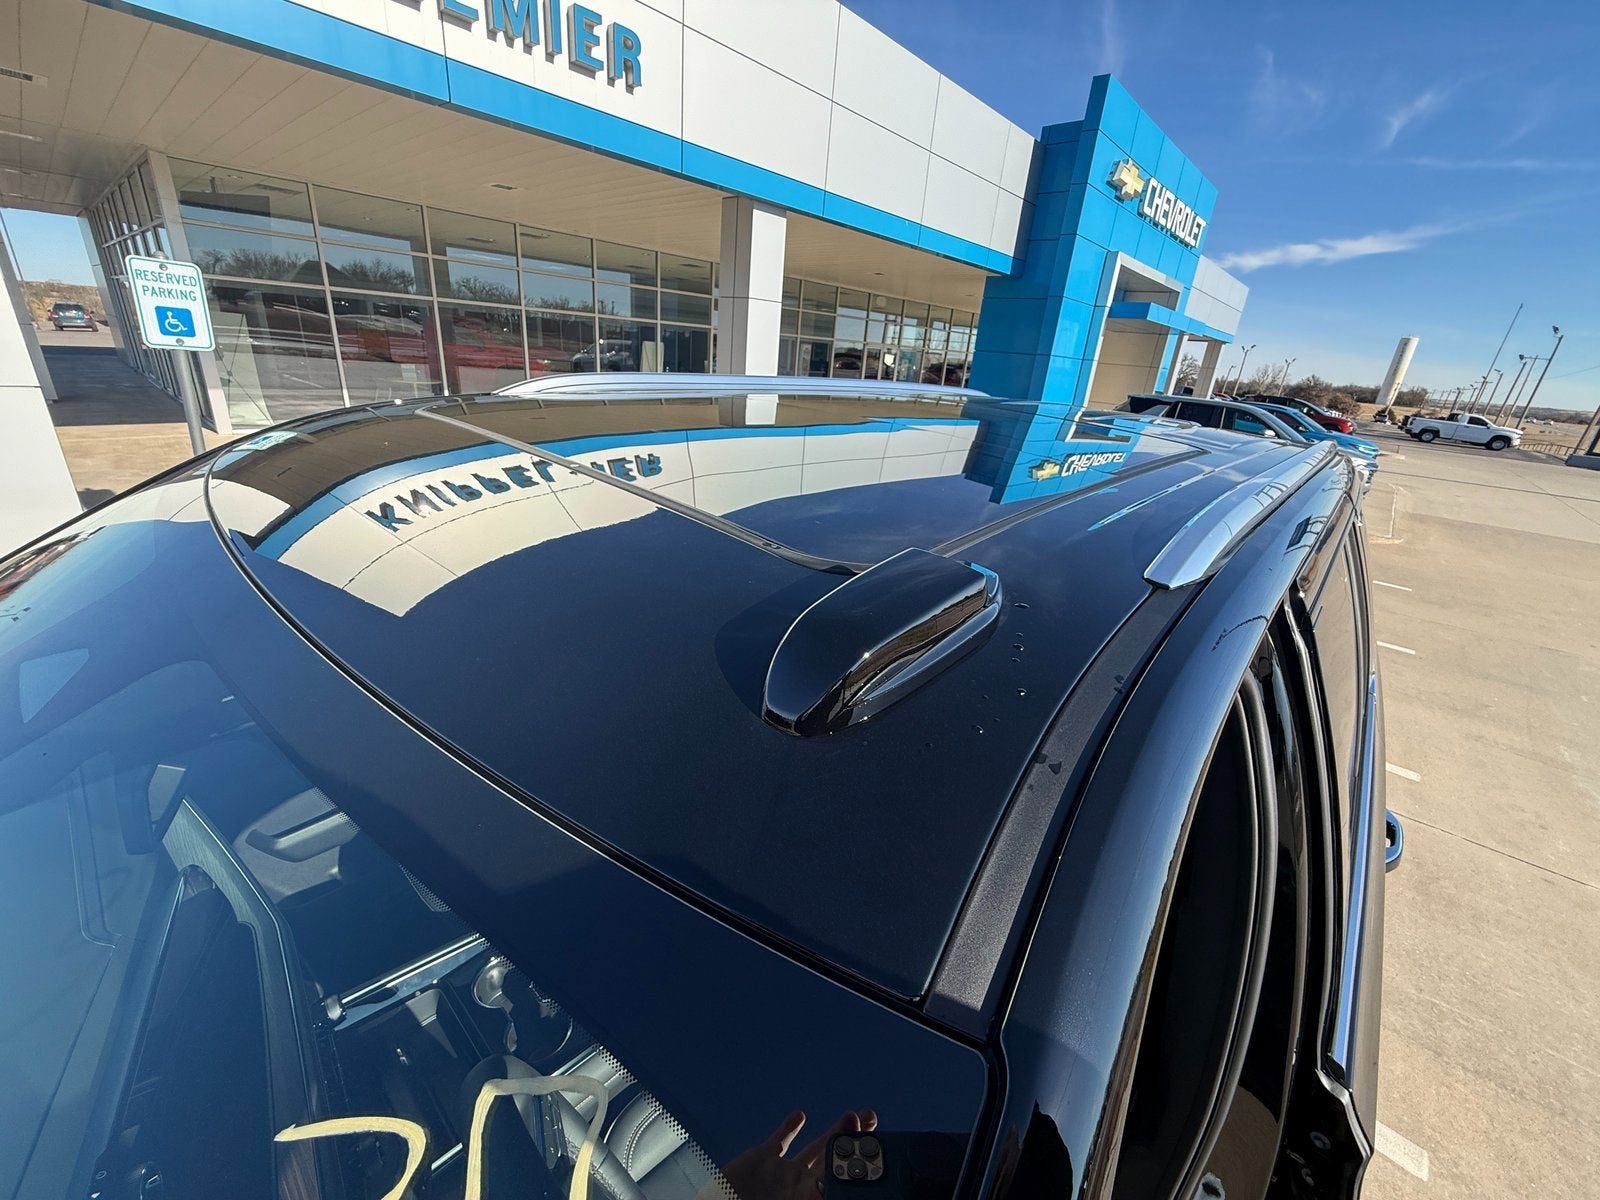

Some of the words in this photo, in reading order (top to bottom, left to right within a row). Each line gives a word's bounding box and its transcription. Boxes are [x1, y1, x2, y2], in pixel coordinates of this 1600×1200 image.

[1142, 176, 1207, 248] CHEVROLET
[134, 268, 197, 287] RESERVED
[142, 284, 197, 302] PARKING
